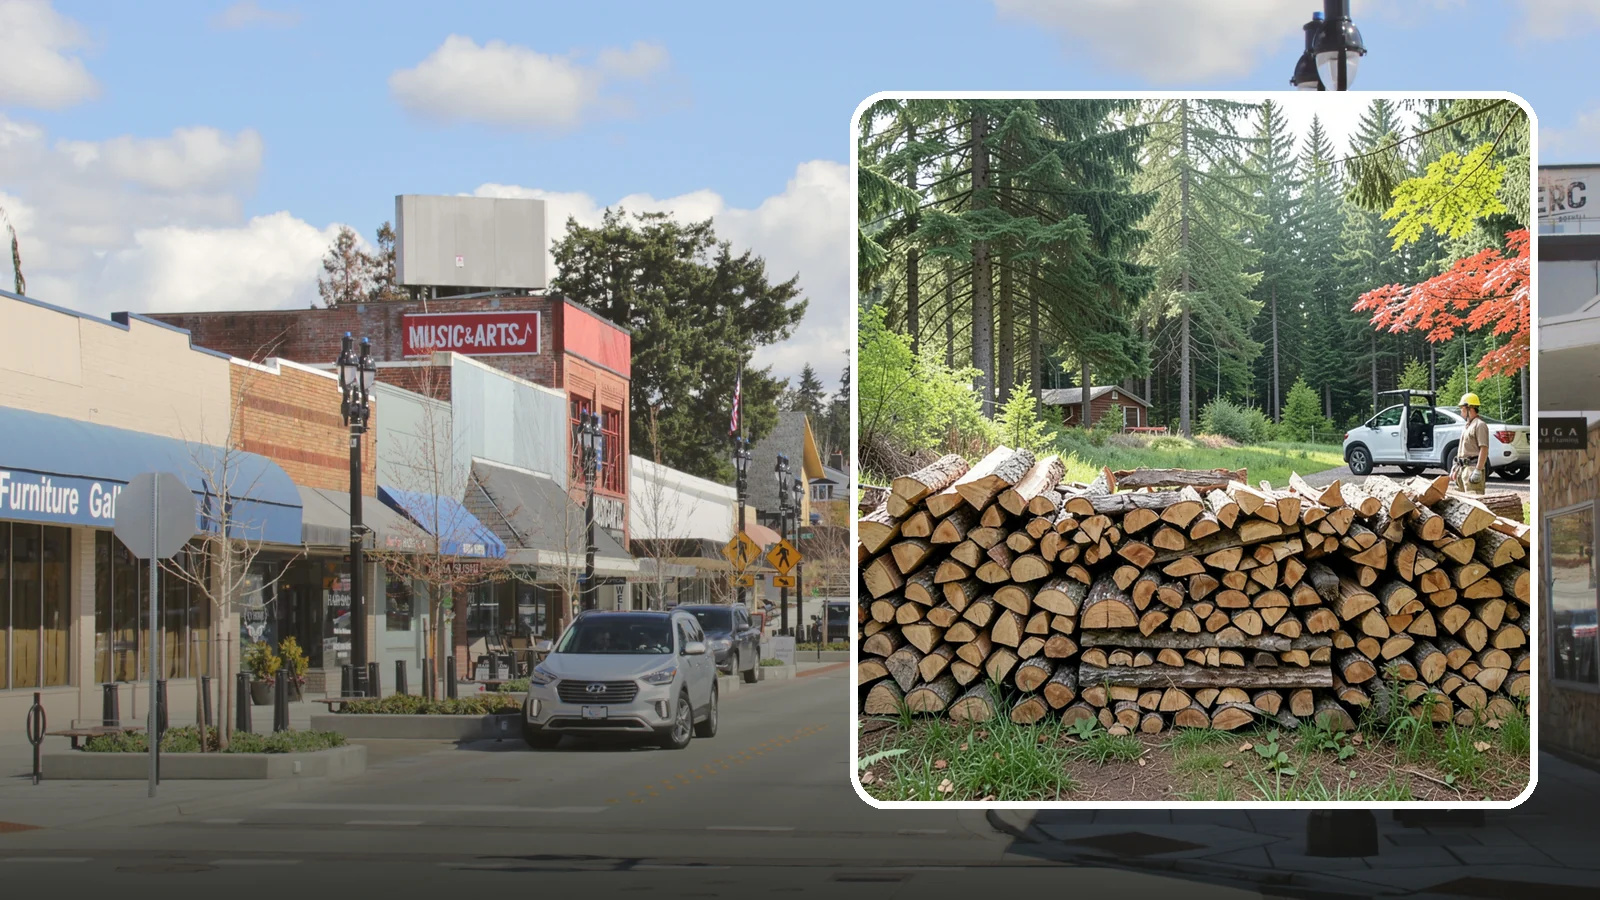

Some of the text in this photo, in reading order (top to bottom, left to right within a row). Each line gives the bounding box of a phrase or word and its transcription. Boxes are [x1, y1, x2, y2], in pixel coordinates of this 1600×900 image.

[1540, 427, 1577, 437] UGA
[0, 471, 122, 519] Furniture Gal
[453, 563, 479, 574] SUSHI
